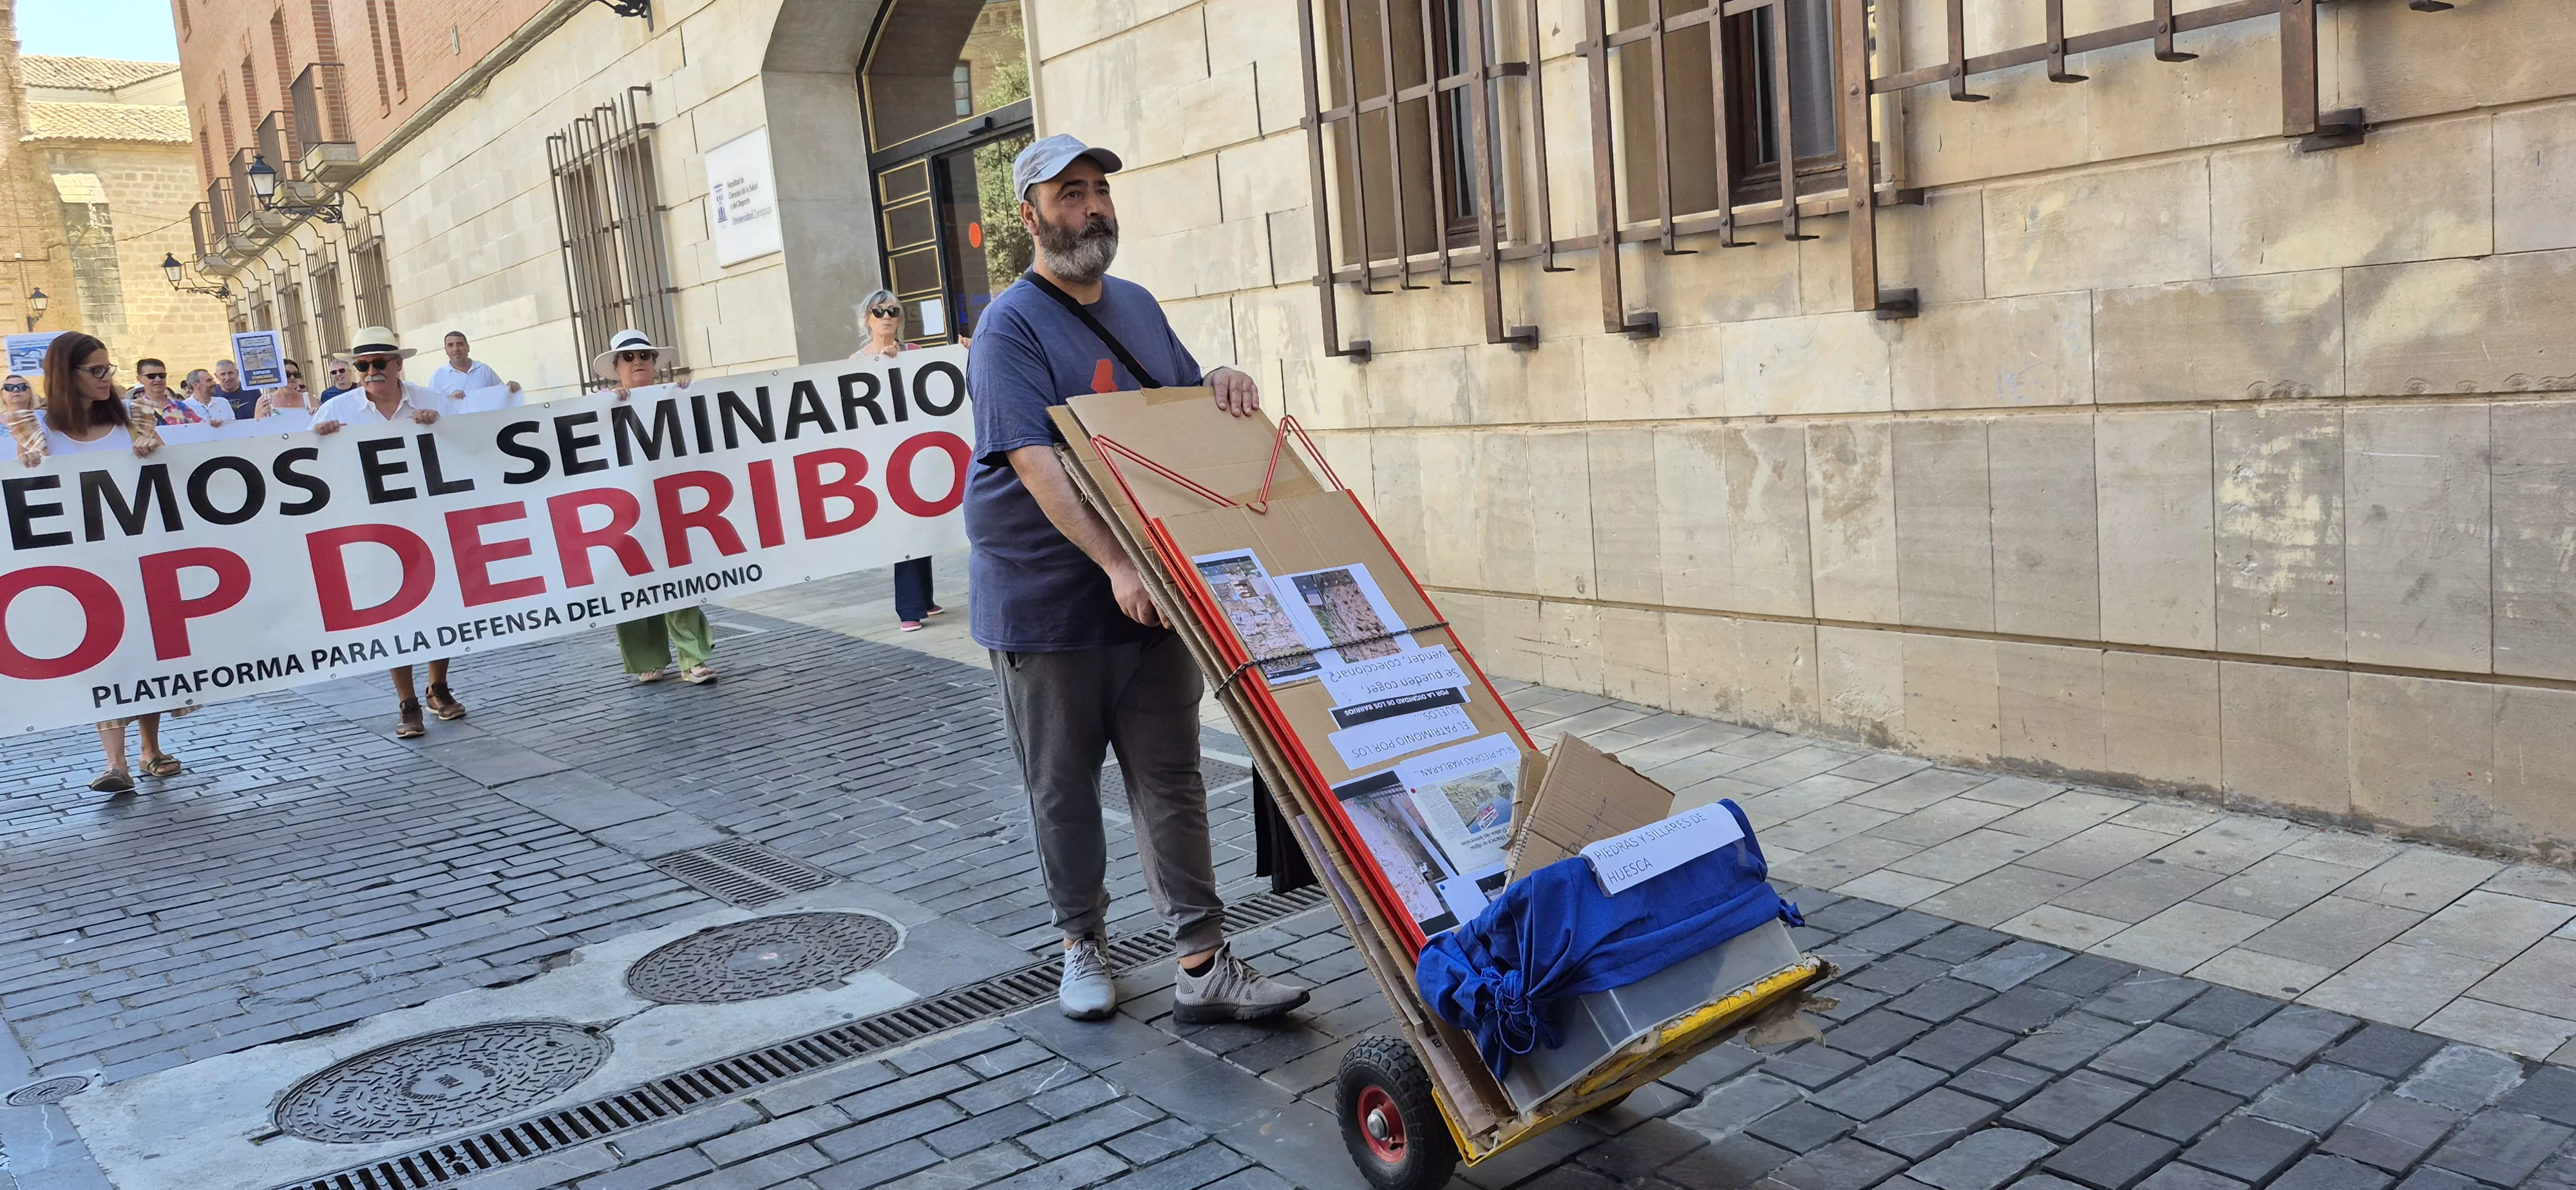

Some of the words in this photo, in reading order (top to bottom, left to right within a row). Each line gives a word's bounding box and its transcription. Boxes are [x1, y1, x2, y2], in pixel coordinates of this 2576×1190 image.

[727, 178, 741, 188] Facultad
[749, 182, 759, 192] Salud
[737, 198, 751, 207] Deporte
[3, 448, 330, 550] EMOS
[357, 433, 475, 504] EL
[496, 361, 965, 484] SEMINARIO
[0, 547, 251, 679] OP
[306, 431, 972, 632] DERRIBO
[91, 654, 305, 708] PLATAFORMA
[311, 639, 388, 672] PARA
[394, 630, 431, 655] LA
[437, 607, 562, 647] DEFENSA
[567, 596, 615, 621] DEL
[621, 563, 762, 610] PATRIMONIO
[1402, 650, 1446, 665] vender,
[1330, 659, 1401, 683] coleccionar?
[1401, 669, 1443, 686] pueden
[1444, 668, 1461, 679] Se
[1361, 681, 1399, 694] coger,
[1375, 701, 1386, 709] LOS
[1397, 694, 1426, 704] DIGNIDAD
[1344, 703, 1373, 716] BARRIOS
[1461, 721, 1470, 730] EL
[1396, 725, 1458, 746] PATRIMONIO
[1352, 746, 1372, 758] LOS
[1375, 741, 1394, 750] POR
[1466, 752, 1497, 765] PIEDRAS
[1488, 835, 1506, 845] Huesca
[1593, 837, 1640, 860] PIEDRAS
[1640, 834, 1647, 843] Y
[1645, 818, 1691, 841] SILLARES
[1691, 813, 1707, 824] DE
[1607, 858, 1654, 884] HUESCA
